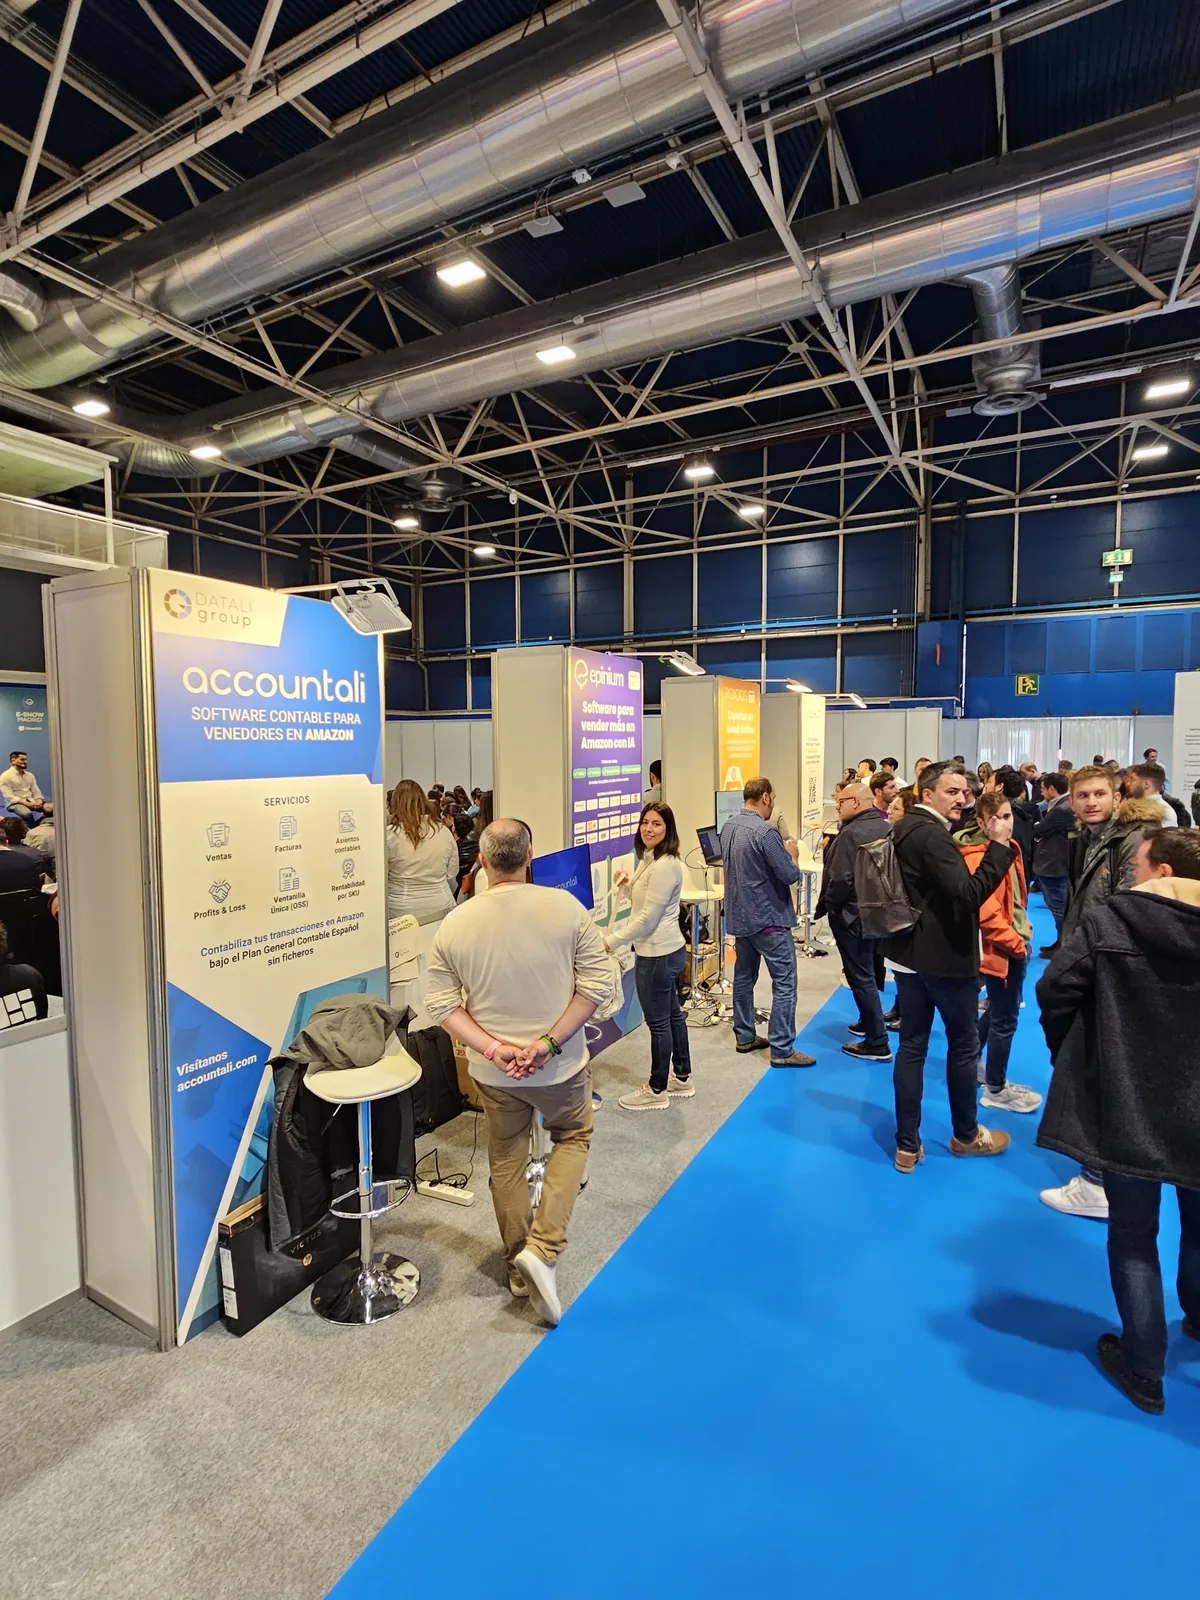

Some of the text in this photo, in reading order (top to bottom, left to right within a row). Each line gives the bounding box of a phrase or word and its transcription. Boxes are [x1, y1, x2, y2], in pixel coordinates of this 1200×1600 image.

[196, 592, 252, 613] DATALI
[198, 610, 252, 628] group
[590, 666, 624, 687] epinium
[182, 666, 366, 704] accountali
[191, 707, 361, 725] SOFTWARE CONTABLE PARA
[582, 700, 634, 718] Software para
[581, 718, 635, 732] vender más en
[204, 726, 354, 741] VENEDORES EN AMAZON
[581, 736, 635, 749] Amazon con IA
[264, 796, 310, 806] SERVICIOS
[336, 836, 359, 844] Asientos
[274, 844, 302, 852] Facturas
[334, 844, 360, 854] contables
[206, 853, 232, 862] Ventas
[331, 880, 365, 892] Rentabilidad
[273, 892, 306, 904] Ventanilla
[348, 890, 360, 898] SKU
[194, 909, 220, 919] Profits
[229, 904, 246, 913] Loss
[271, 900, 309, 914] Única (OSS)
[200, 938, 252, 957] Contabiliza
[254, 934, 268, 944] tus
[270, 921, 324, 940] transacciones
[336, 911, 364, 924] Amazon
[209, 923, 359, 969] bajo el Plan General Contable Español
[268, 947, 314, 966] sin ficheros
[176, 1051, 228, 1077] Visítanos
[177, 1054, 257, 1093] accountali.com
[290, 1231, 322, 1254] VICTUS
